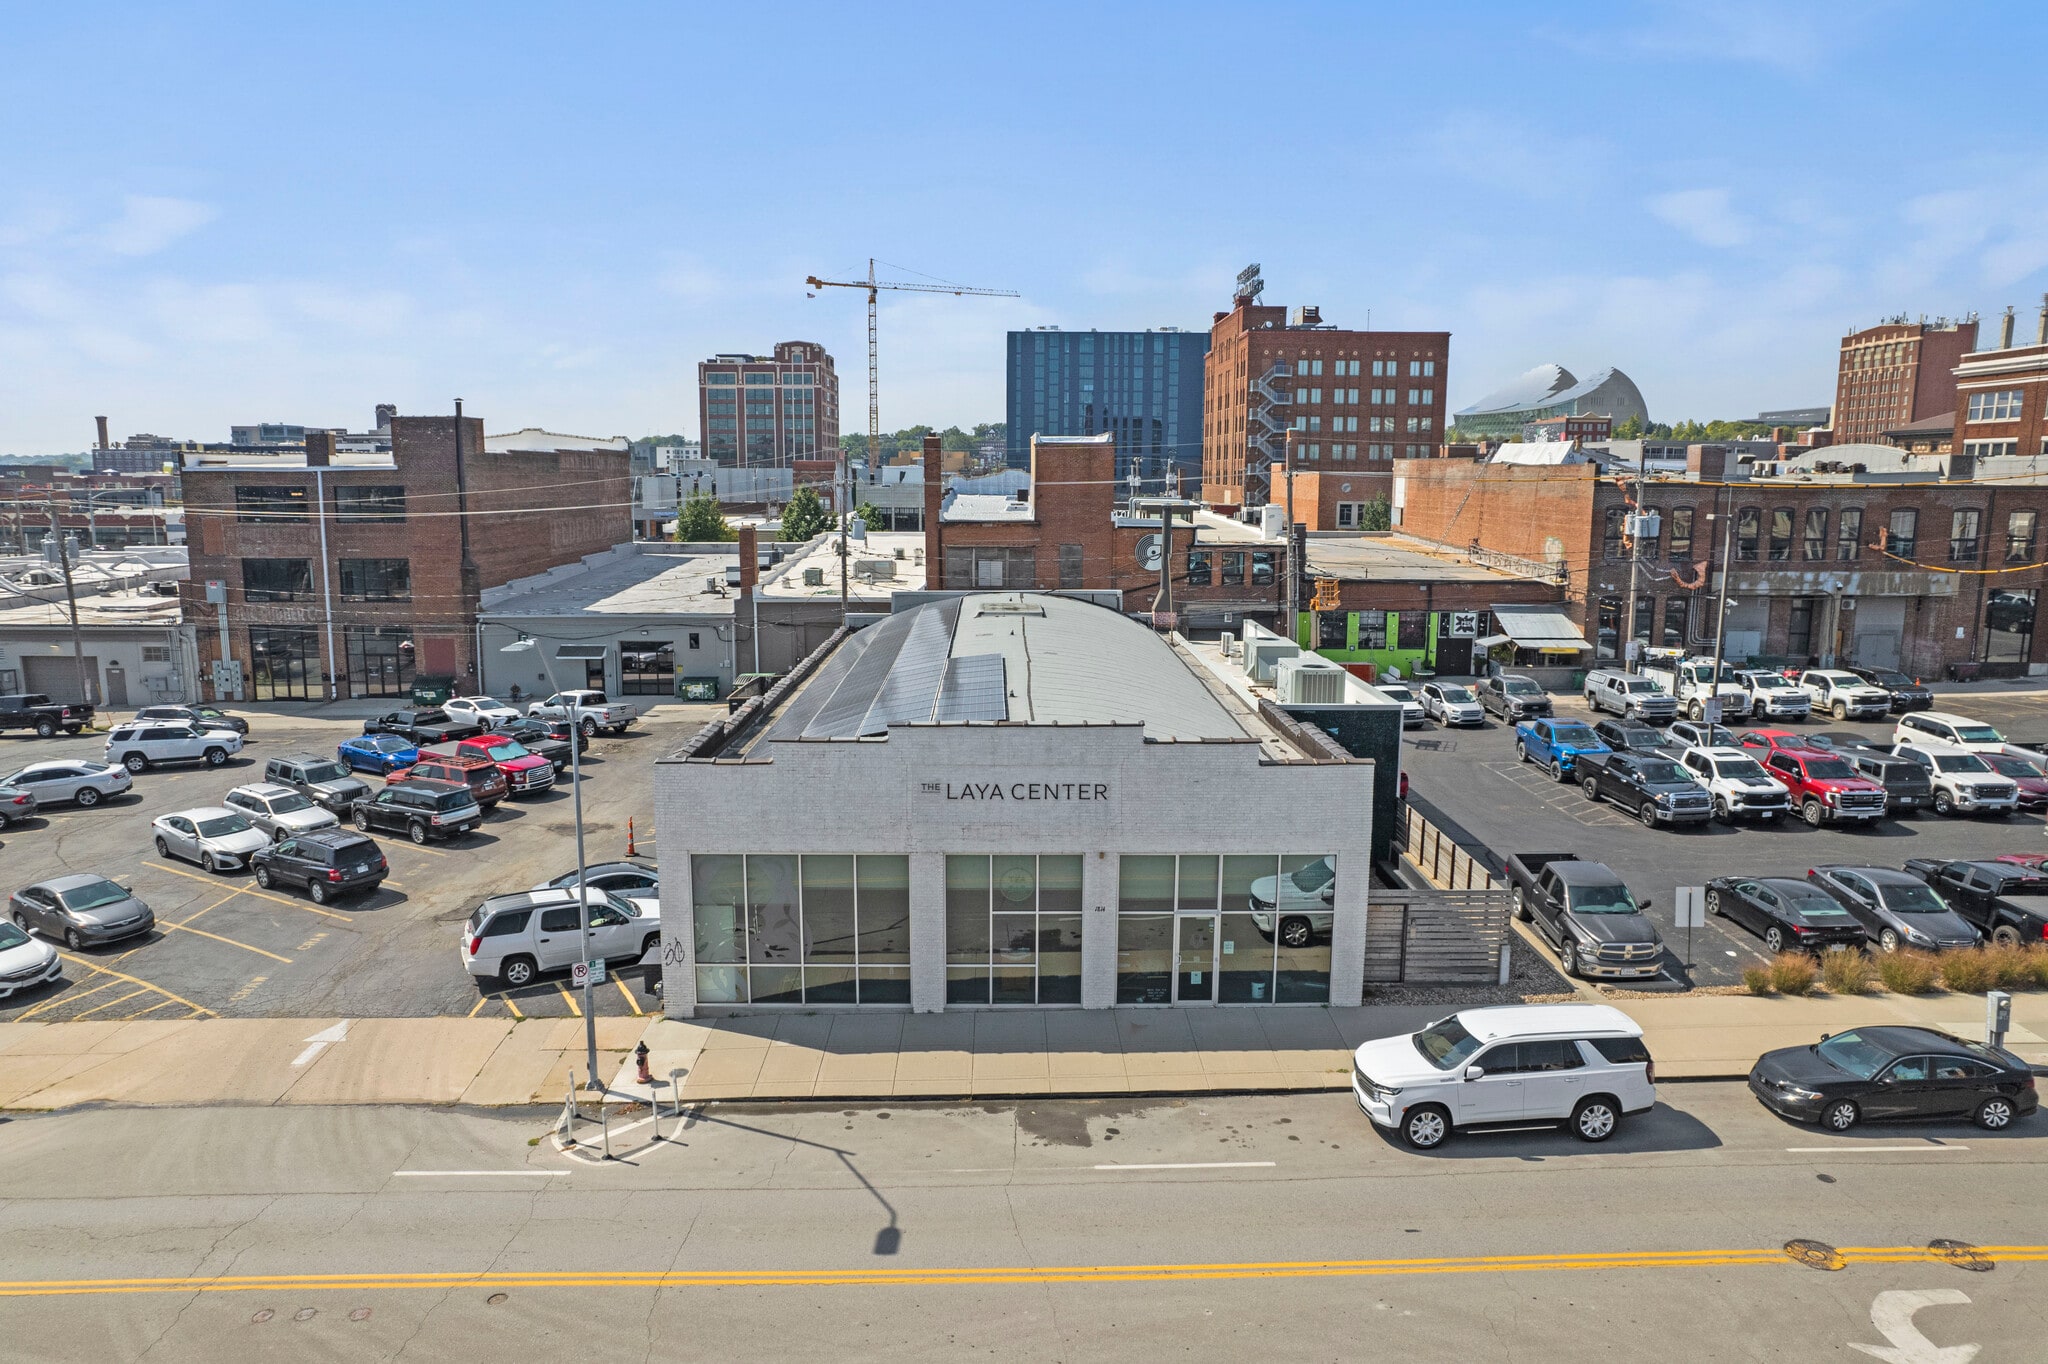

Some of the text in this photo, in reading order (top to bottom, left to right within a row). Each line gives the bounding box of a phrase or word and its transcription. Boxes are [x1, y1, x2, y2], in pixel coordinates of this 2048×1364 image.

[921, 783, 1108, 800] THE LAYA CENTER
